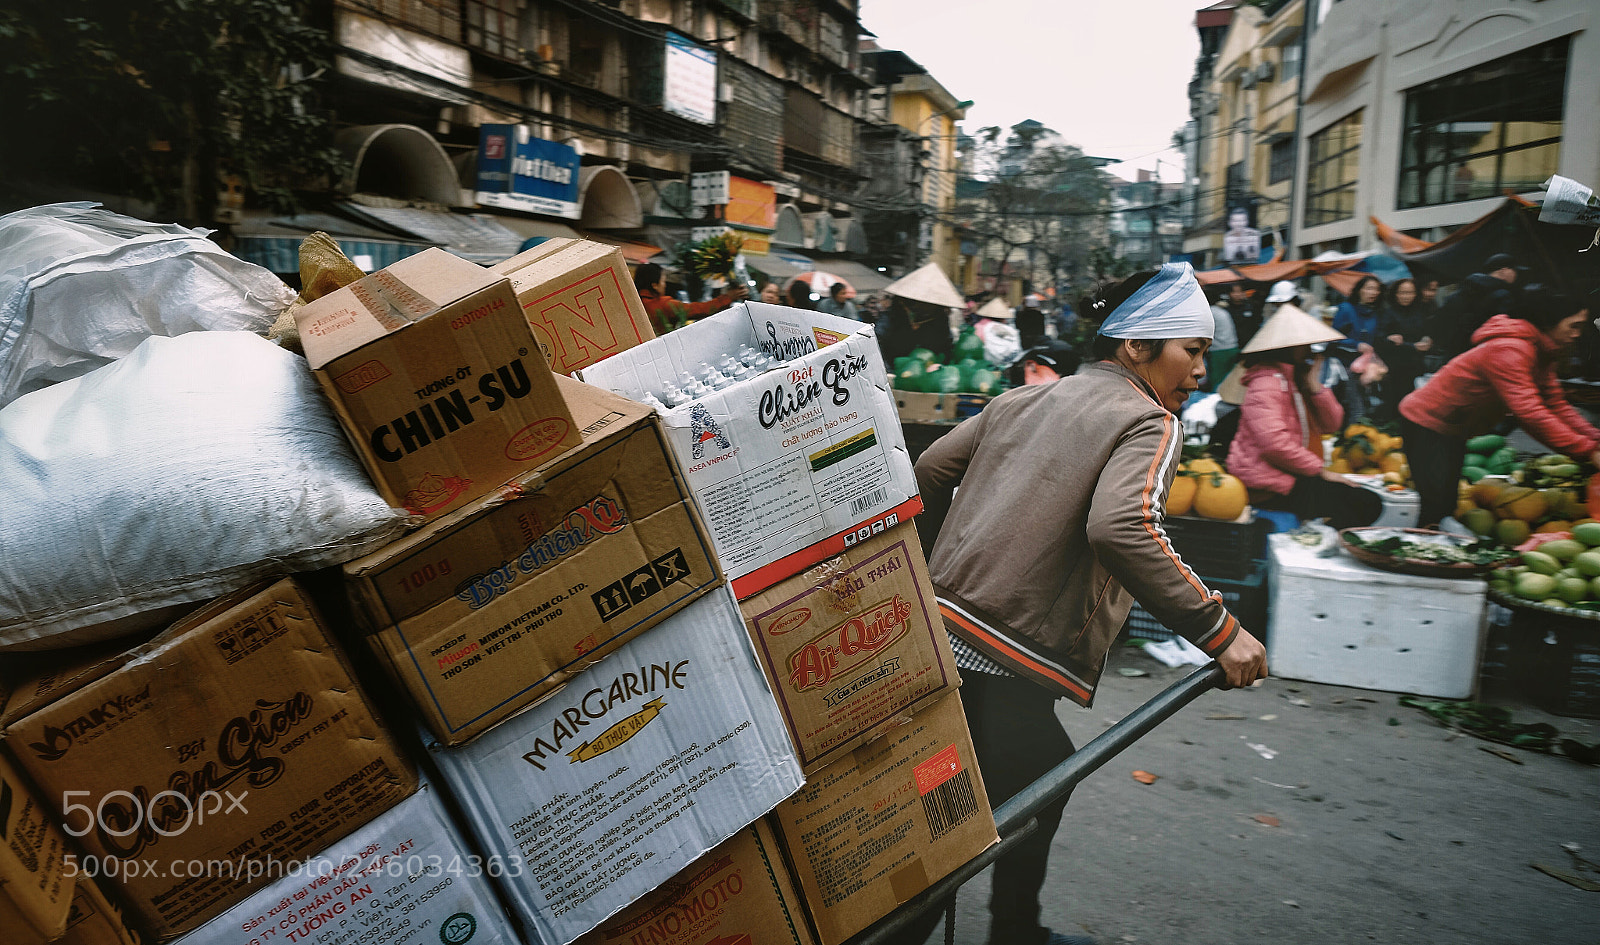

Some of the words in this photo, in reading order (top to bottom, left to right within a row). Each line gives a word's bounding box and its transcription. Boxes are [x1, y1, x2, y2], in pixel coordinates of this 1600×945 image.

[758, 381, 823, 429] Chiên
[822, 354, 869, 406] Giòn
[786, 366, 814, 386] Bột
[370, 359, 531, 463] CHIN-SU
[689, 462, 706, 474] ASEA
[518, 522, 592, 577] chiên
[867, 556, 901, 582] THÁI
[437, 641, 479, 670] Miwon
[478, 624, 512, 646] MIWON
[512, 602, 551, 627] VIETNAM
[568, 583, 588, 596] LTD.
[441, 666, 462, 680] THO
[462, 654, 482, 670] SON
[485, 640, 506, 655] VIET
[505, 631, 522, 644] TRI
[524, 618, 544, 633] PHU
[543, 608, 563, 622] THO
[789, 595, 912, 690] Aji-Quick
[280, 731, 311, 754] CRISPY
[312, 720, 329, 735] FRY
[330, 708, 348, 723] MIX
[522, 659, 689, 771] MARGARINE
[605, 726, 628, 745] THỰC
[628, 714, 648, 730] VẬT
[217, 691, 313, 789] Giòn
[260, 820, 287, 840] FOOD
[290, 799, 320, 822] FLOUR
[324, 757, 384, 800] CORPORATION
[609, 790, 626, 802] beta
[673, 792, 686, 803] cho
[509, 810, 541, 831] THÀNH
[538, 825, 554, 836] GIA
[527, 850, 549, 866] mono
[559, 819, 594, 846] diglycerid
[559, 857, 574, 869] cho
[242, 916, 266, 932] Sản
[267, 898, 293, 918] xuất
[293, 887, 309, 901] tại
[332, 858, 358, 876] Nam
[286, 902, 346, 942] TƯỜNG
[350, 884, 372, 906] AN
[360, 910, 384, 927] Việt
[384, 893, 413, 913] Nam.
[401, 878, 452, 915] 38153950
[554, 905, 571, 918] FFA
[260, 926, 276, 940] TY
[678, 908, 724, 941] SEASONING
